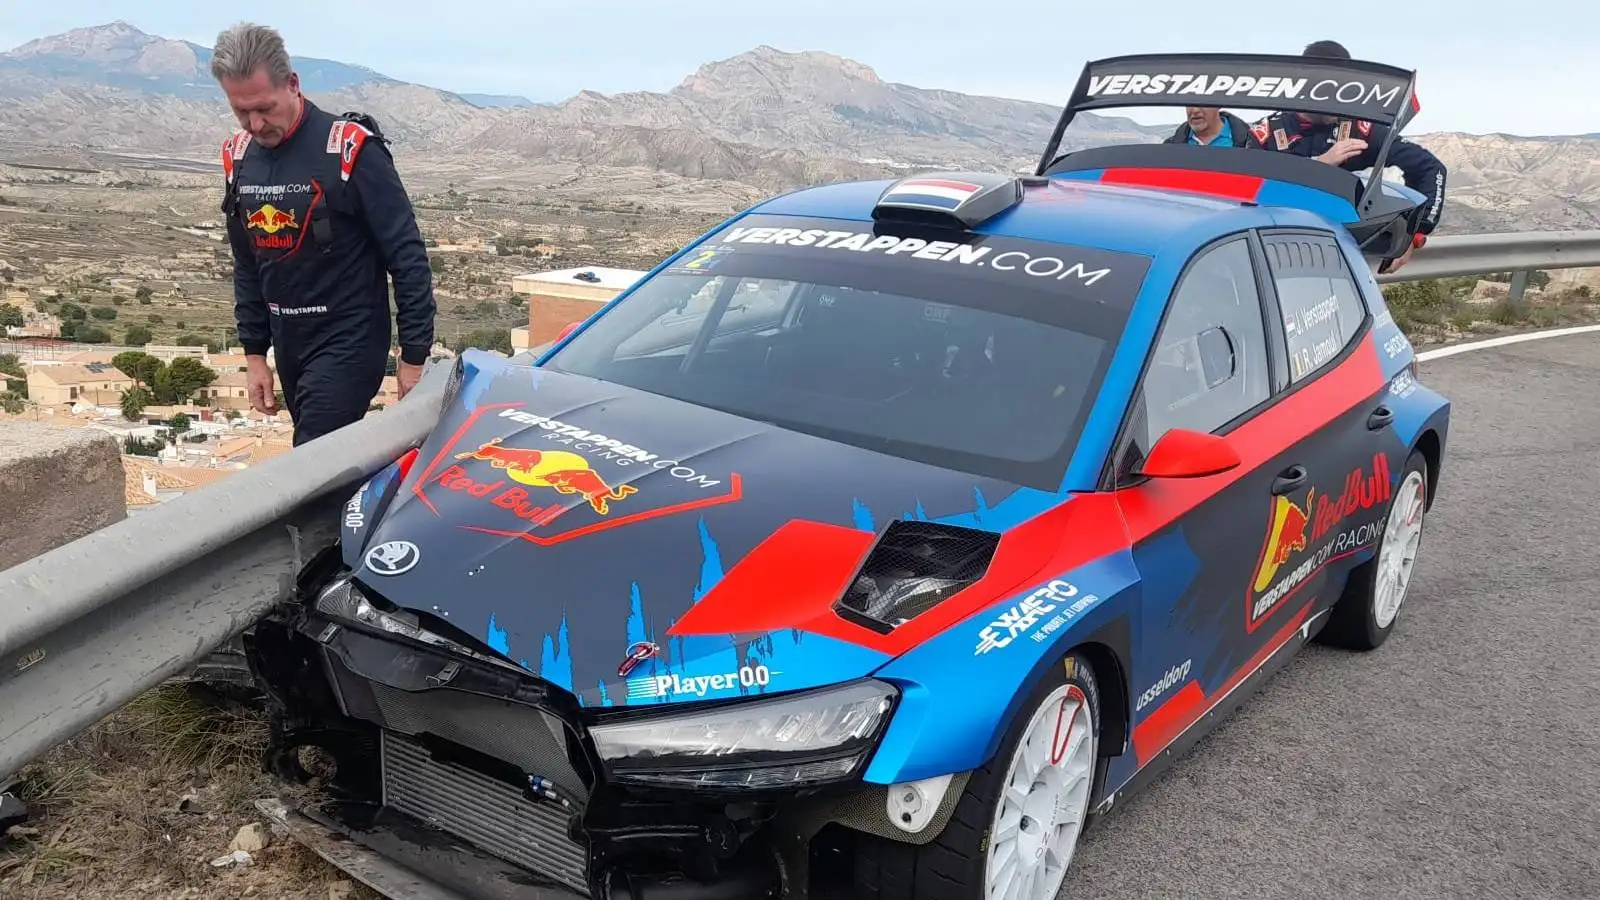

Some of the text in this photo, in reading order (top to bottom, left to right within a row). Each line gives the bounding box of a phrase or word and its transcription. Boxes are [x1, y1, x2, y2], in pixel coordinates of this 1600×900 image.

[1087, 74, 1400, 108] VERSTAPPEN.COM
[239, 184, 311, 194] VERSTAPPEN.COM
[722, 227, 1111, 287] VERSTAPPEN.COM
[280, 305, 328, 315] VERSTAPPEN
[1300, 294, 1340, 331] Verstappen
[498, 407, 721, 489] VERSTAPPEN.COM
[542, 433, 636, 468] RACING
[656, 665, 770, 697] Player 0.0
[1135, 658, 1192, 712] usseldorp
